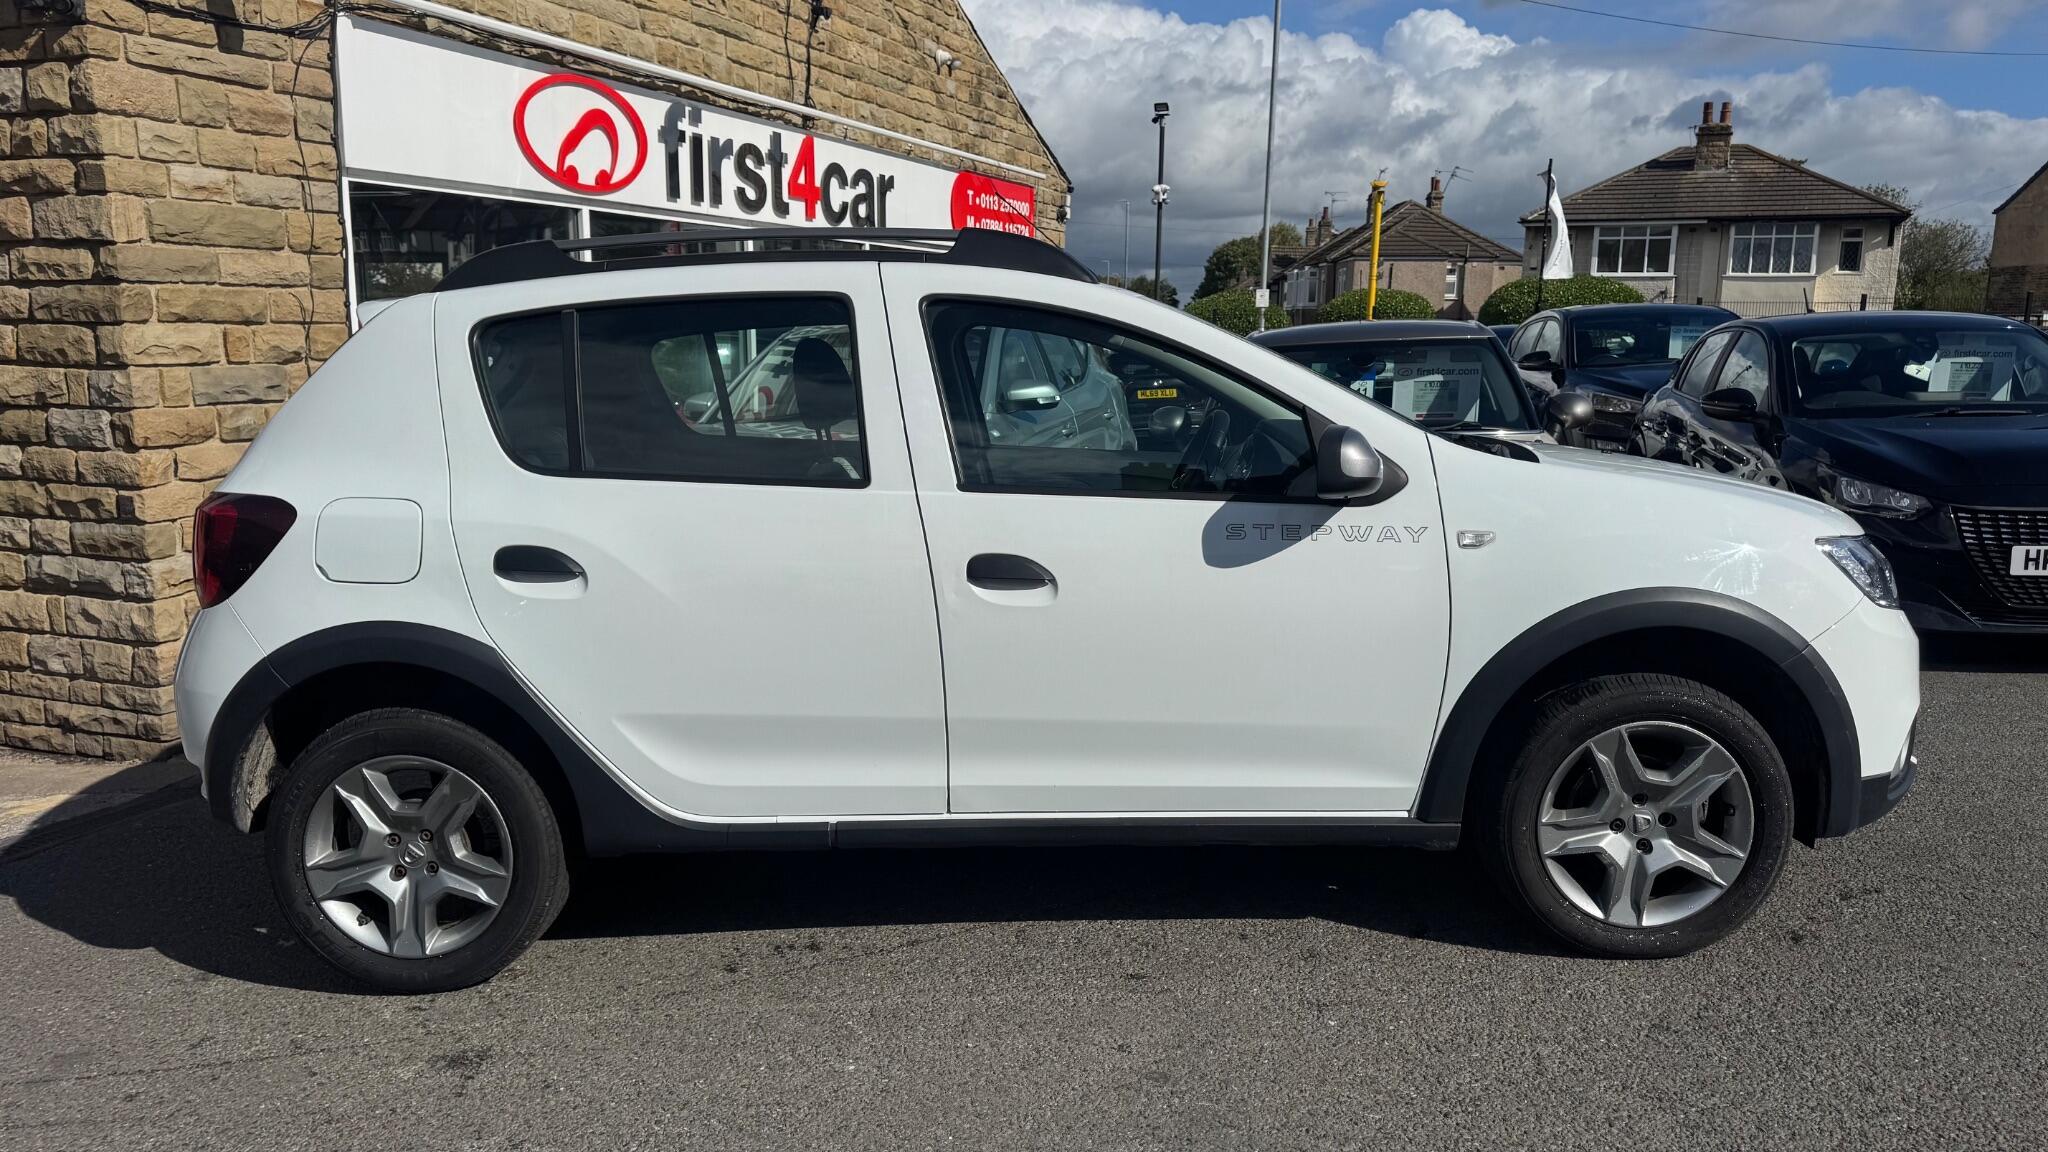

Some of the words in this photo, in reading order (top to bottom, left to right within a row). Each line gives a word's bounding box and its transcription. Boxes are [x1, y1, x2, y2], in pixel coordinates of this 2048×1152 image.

[657, 101, 895, 229] first4car
[967, 189, 974, 206] T
[980, 193, 999, 211] 0113
[1225, 523, 1429, 543] STEPWAY
